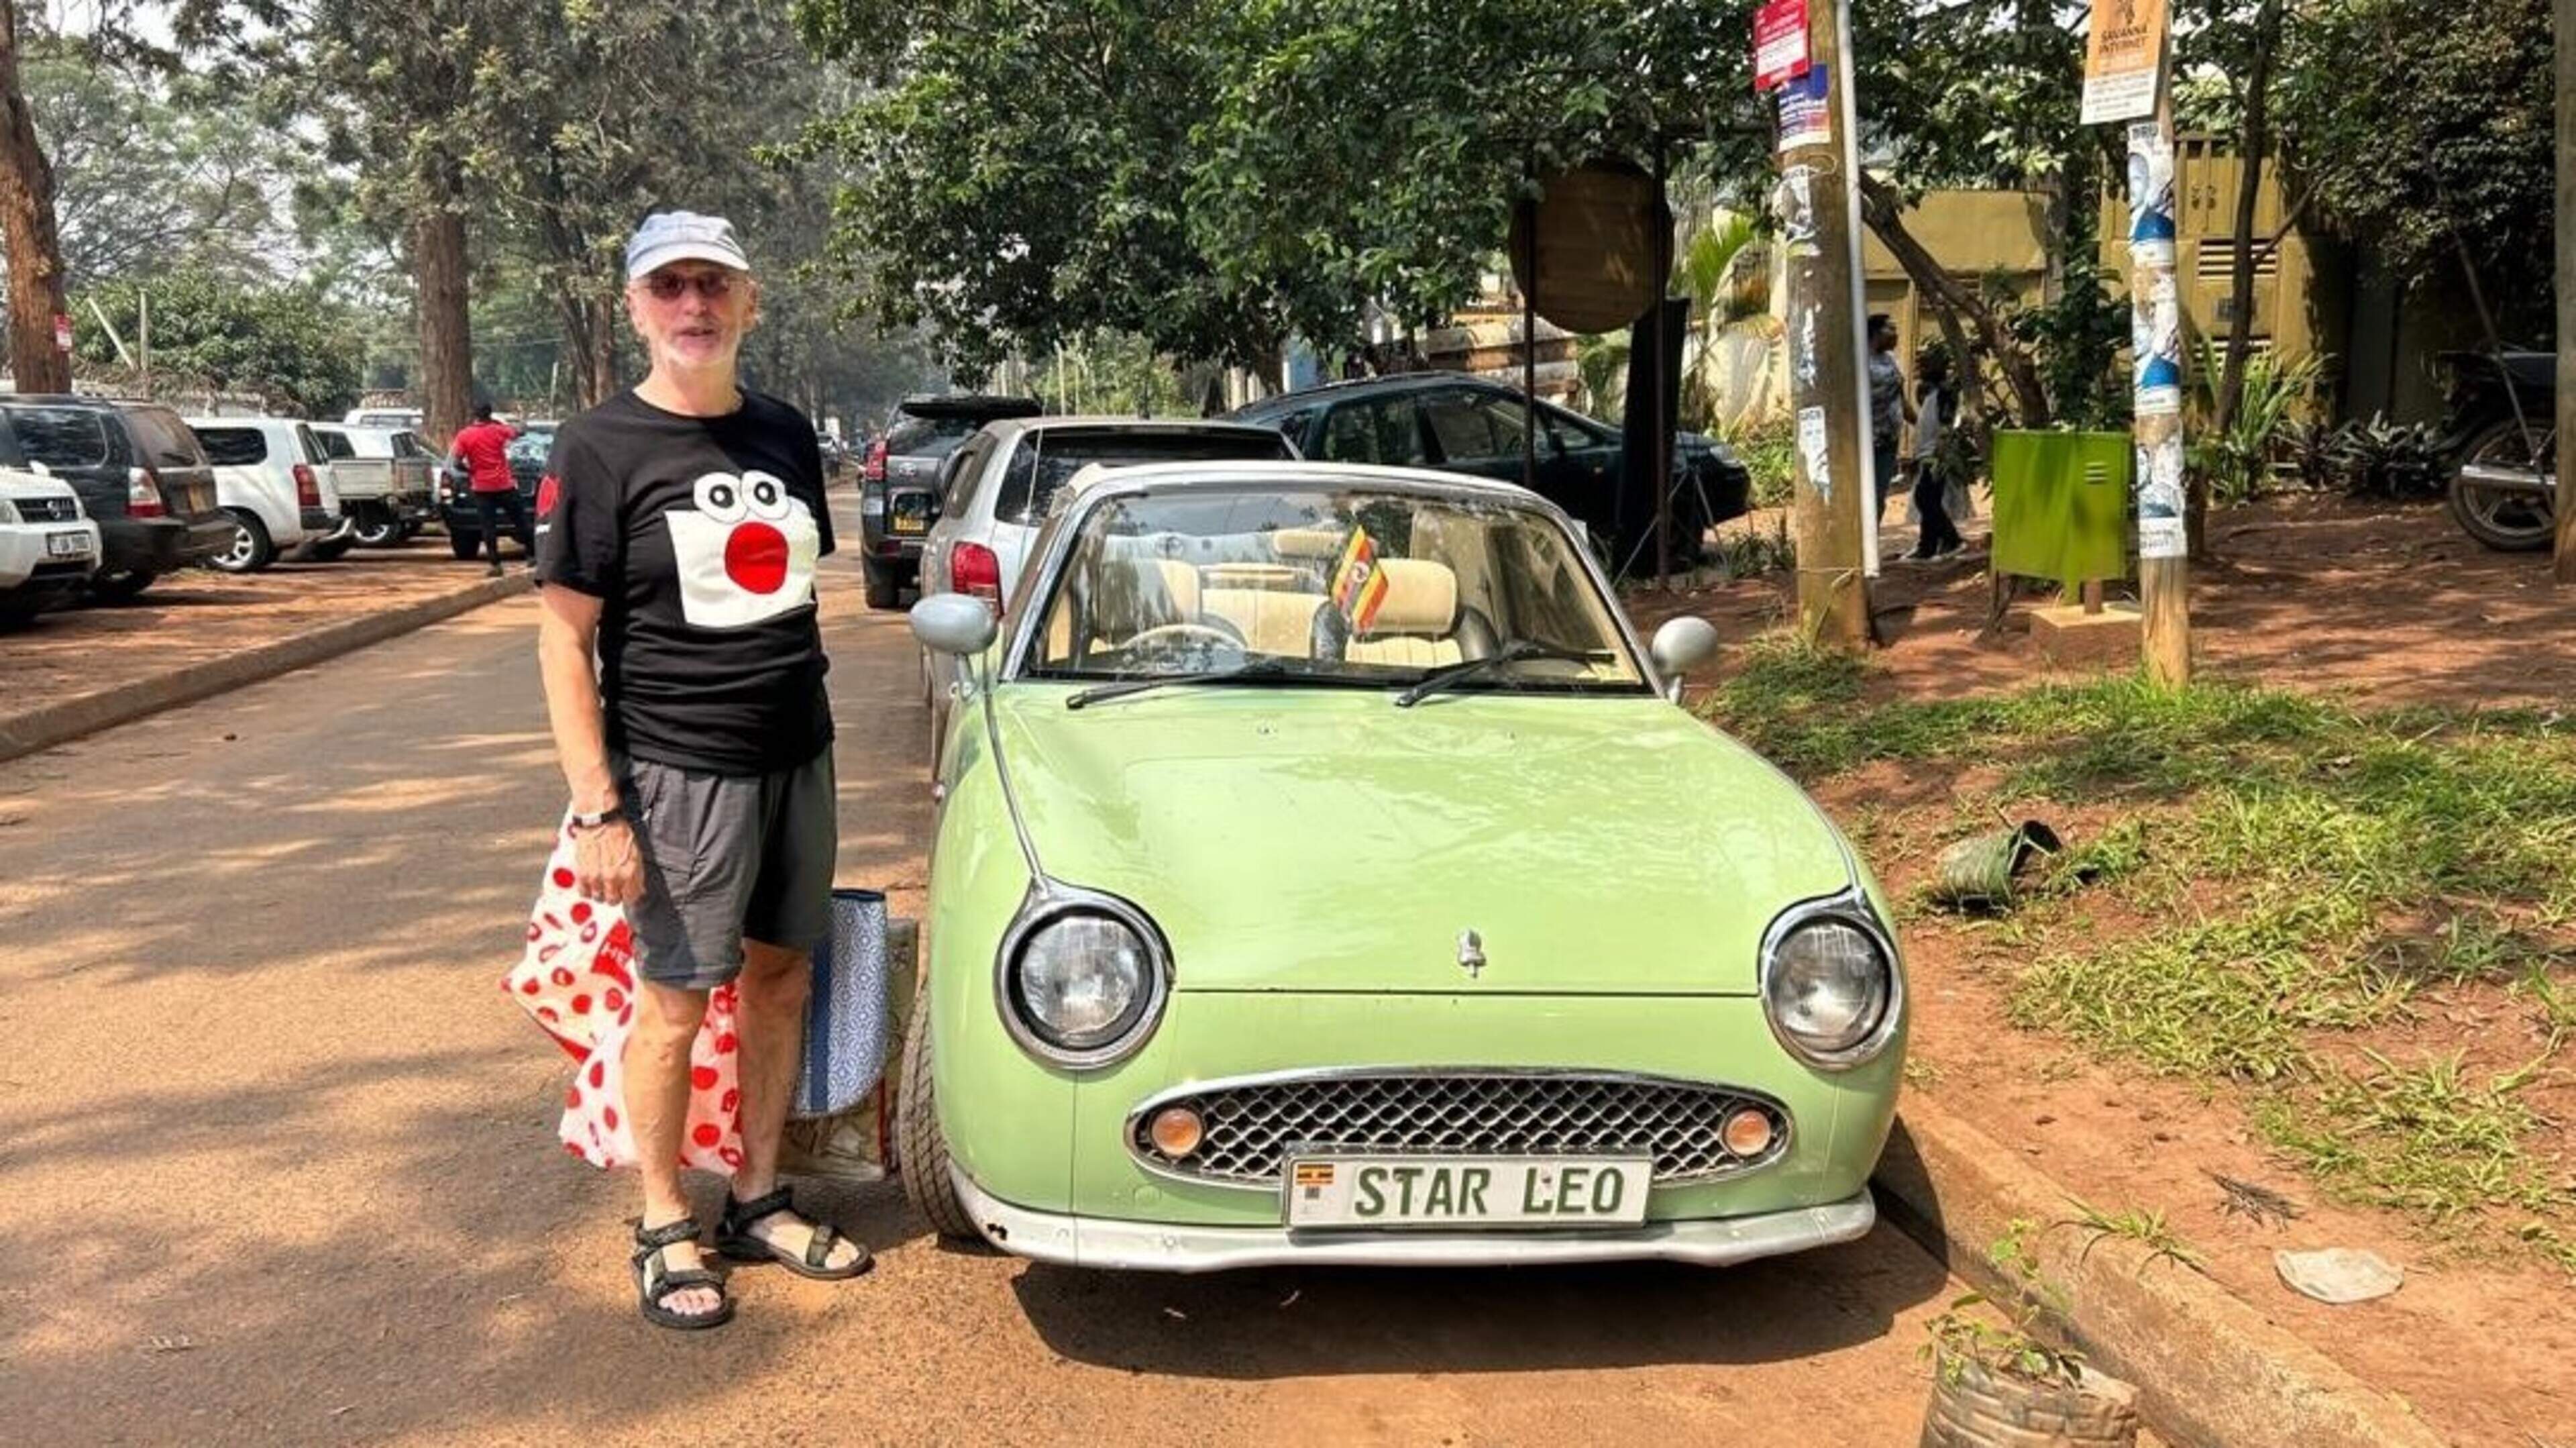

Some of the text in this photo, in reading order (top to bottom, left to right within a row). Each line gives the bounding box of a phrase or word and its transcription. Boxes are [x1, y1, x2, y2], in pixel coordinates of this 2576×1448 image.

[2100, 24, 2149, 42] SAVANNA
[1354, 1167, 1624, 1216] STAR LEO
